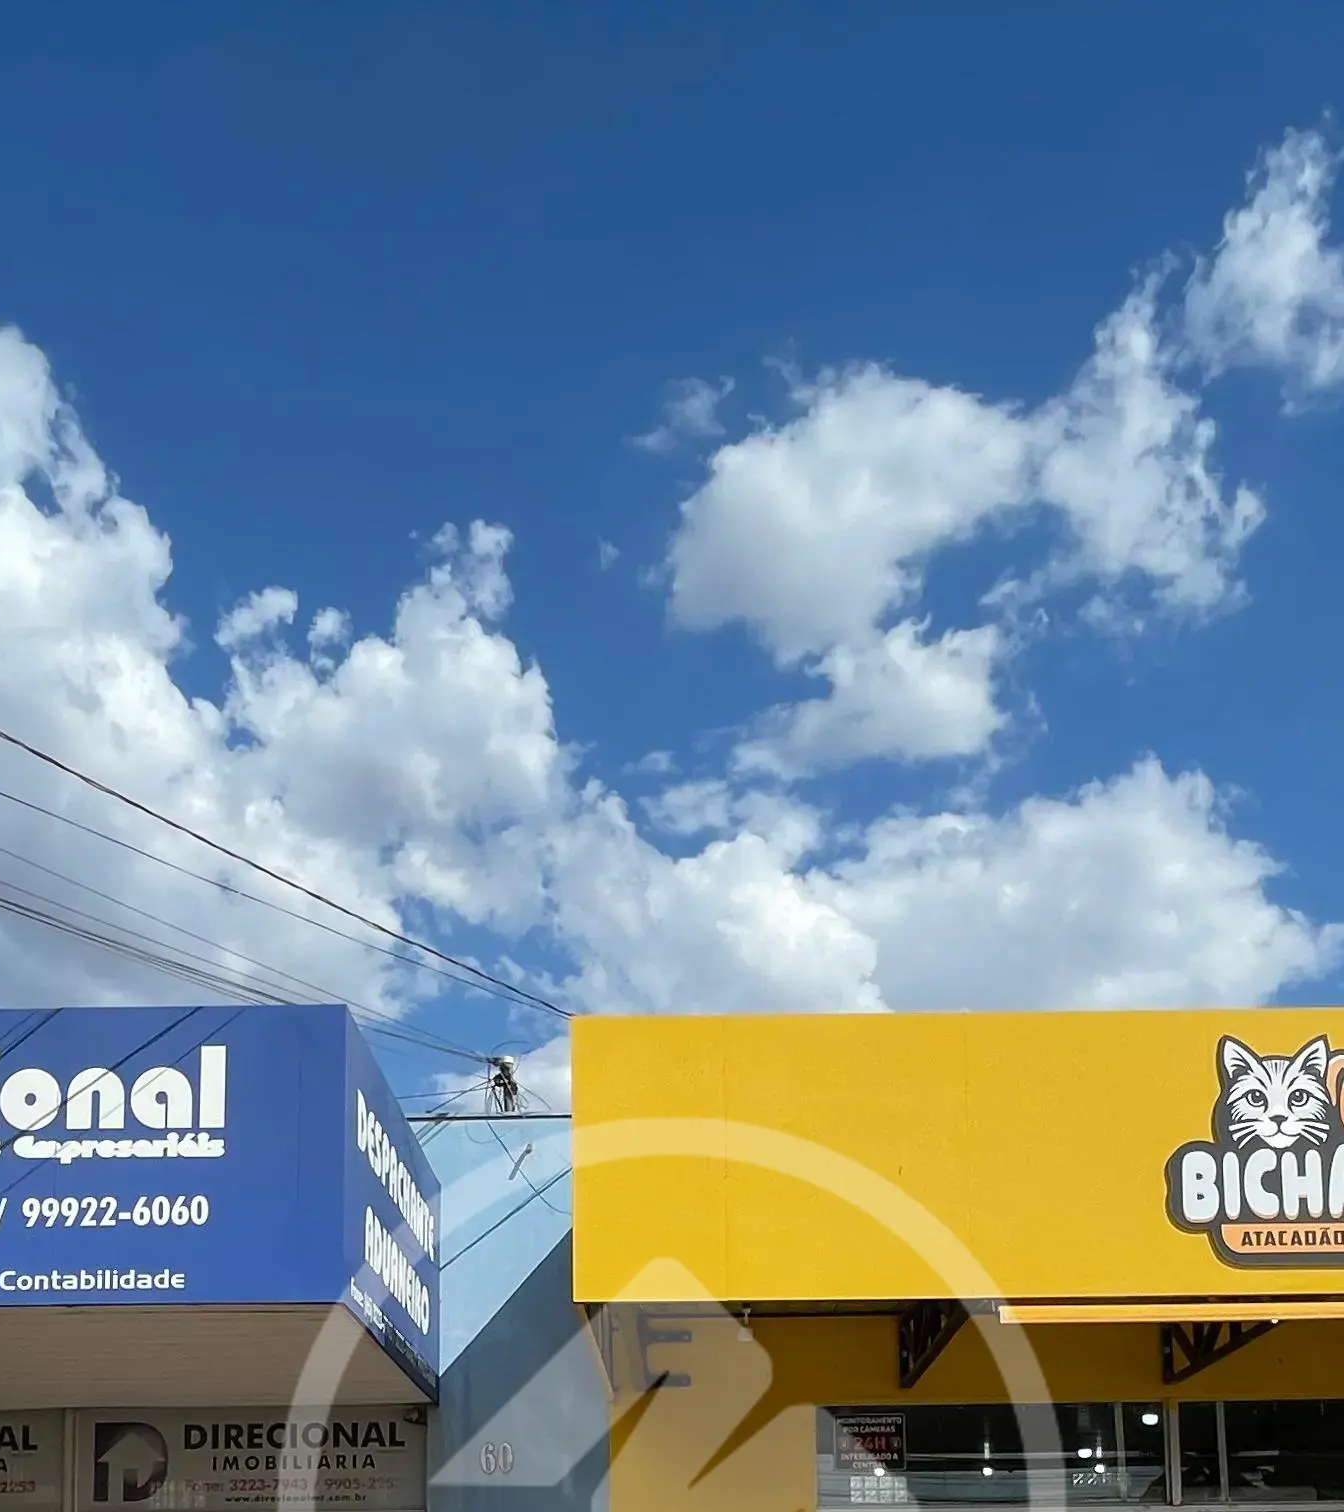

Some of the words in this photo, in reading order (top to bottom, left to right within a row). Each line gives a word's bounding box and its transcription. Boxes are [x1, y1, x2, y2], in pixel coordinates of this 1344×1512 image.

[21, 1195, 210, 1228] 99922-6060
[364, 1205, 431, 1337] ADUANEIRO
[184, 1421, 406, 1450] DIRECIONAL
[212, 1450, 377, 1472] IMOBILIÁRIA
[480, 1441, 515, 1475] 60
[229, 1477, 309, 1492] 3223-7943
